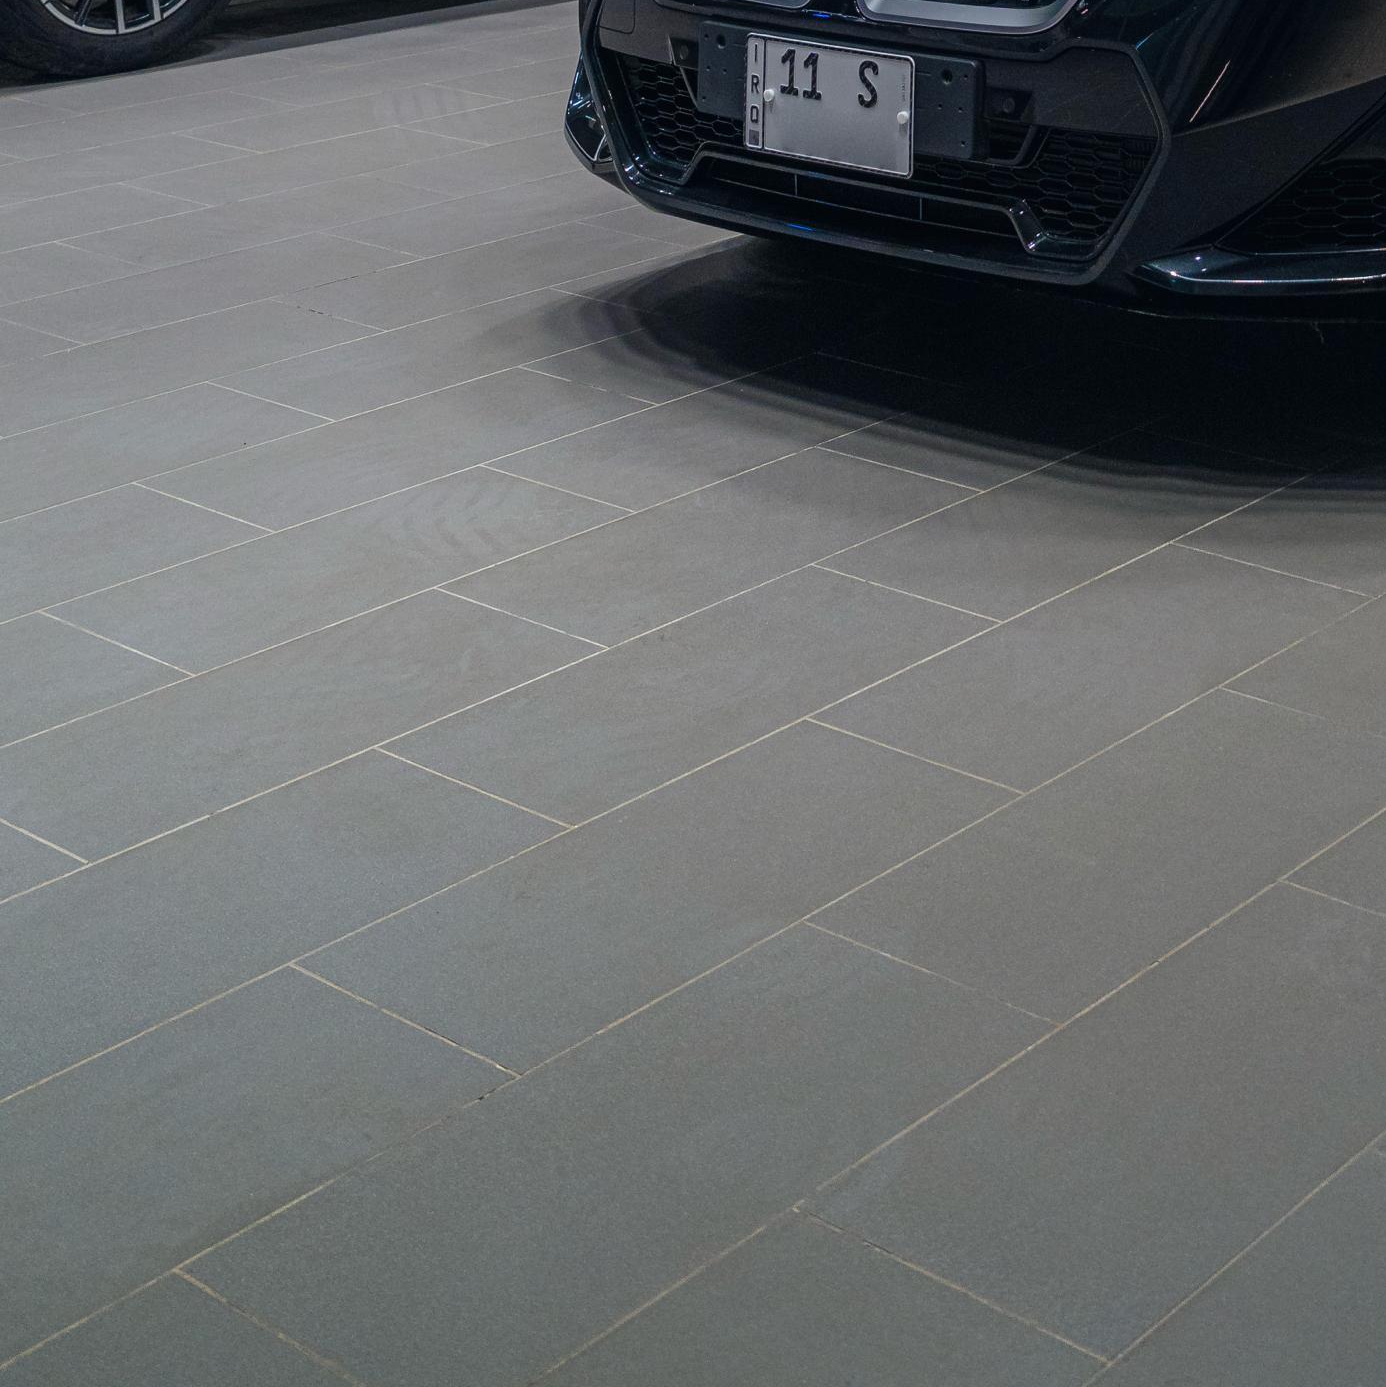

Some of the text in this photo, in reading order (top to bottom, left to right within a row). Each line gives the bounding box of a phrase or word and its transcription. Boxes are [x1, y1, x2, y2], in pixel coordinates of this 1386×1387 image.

[750, 42, 760, 124] IRQ
[780, 48, 822, 100] 11
[857, 60, 880, 108] S
